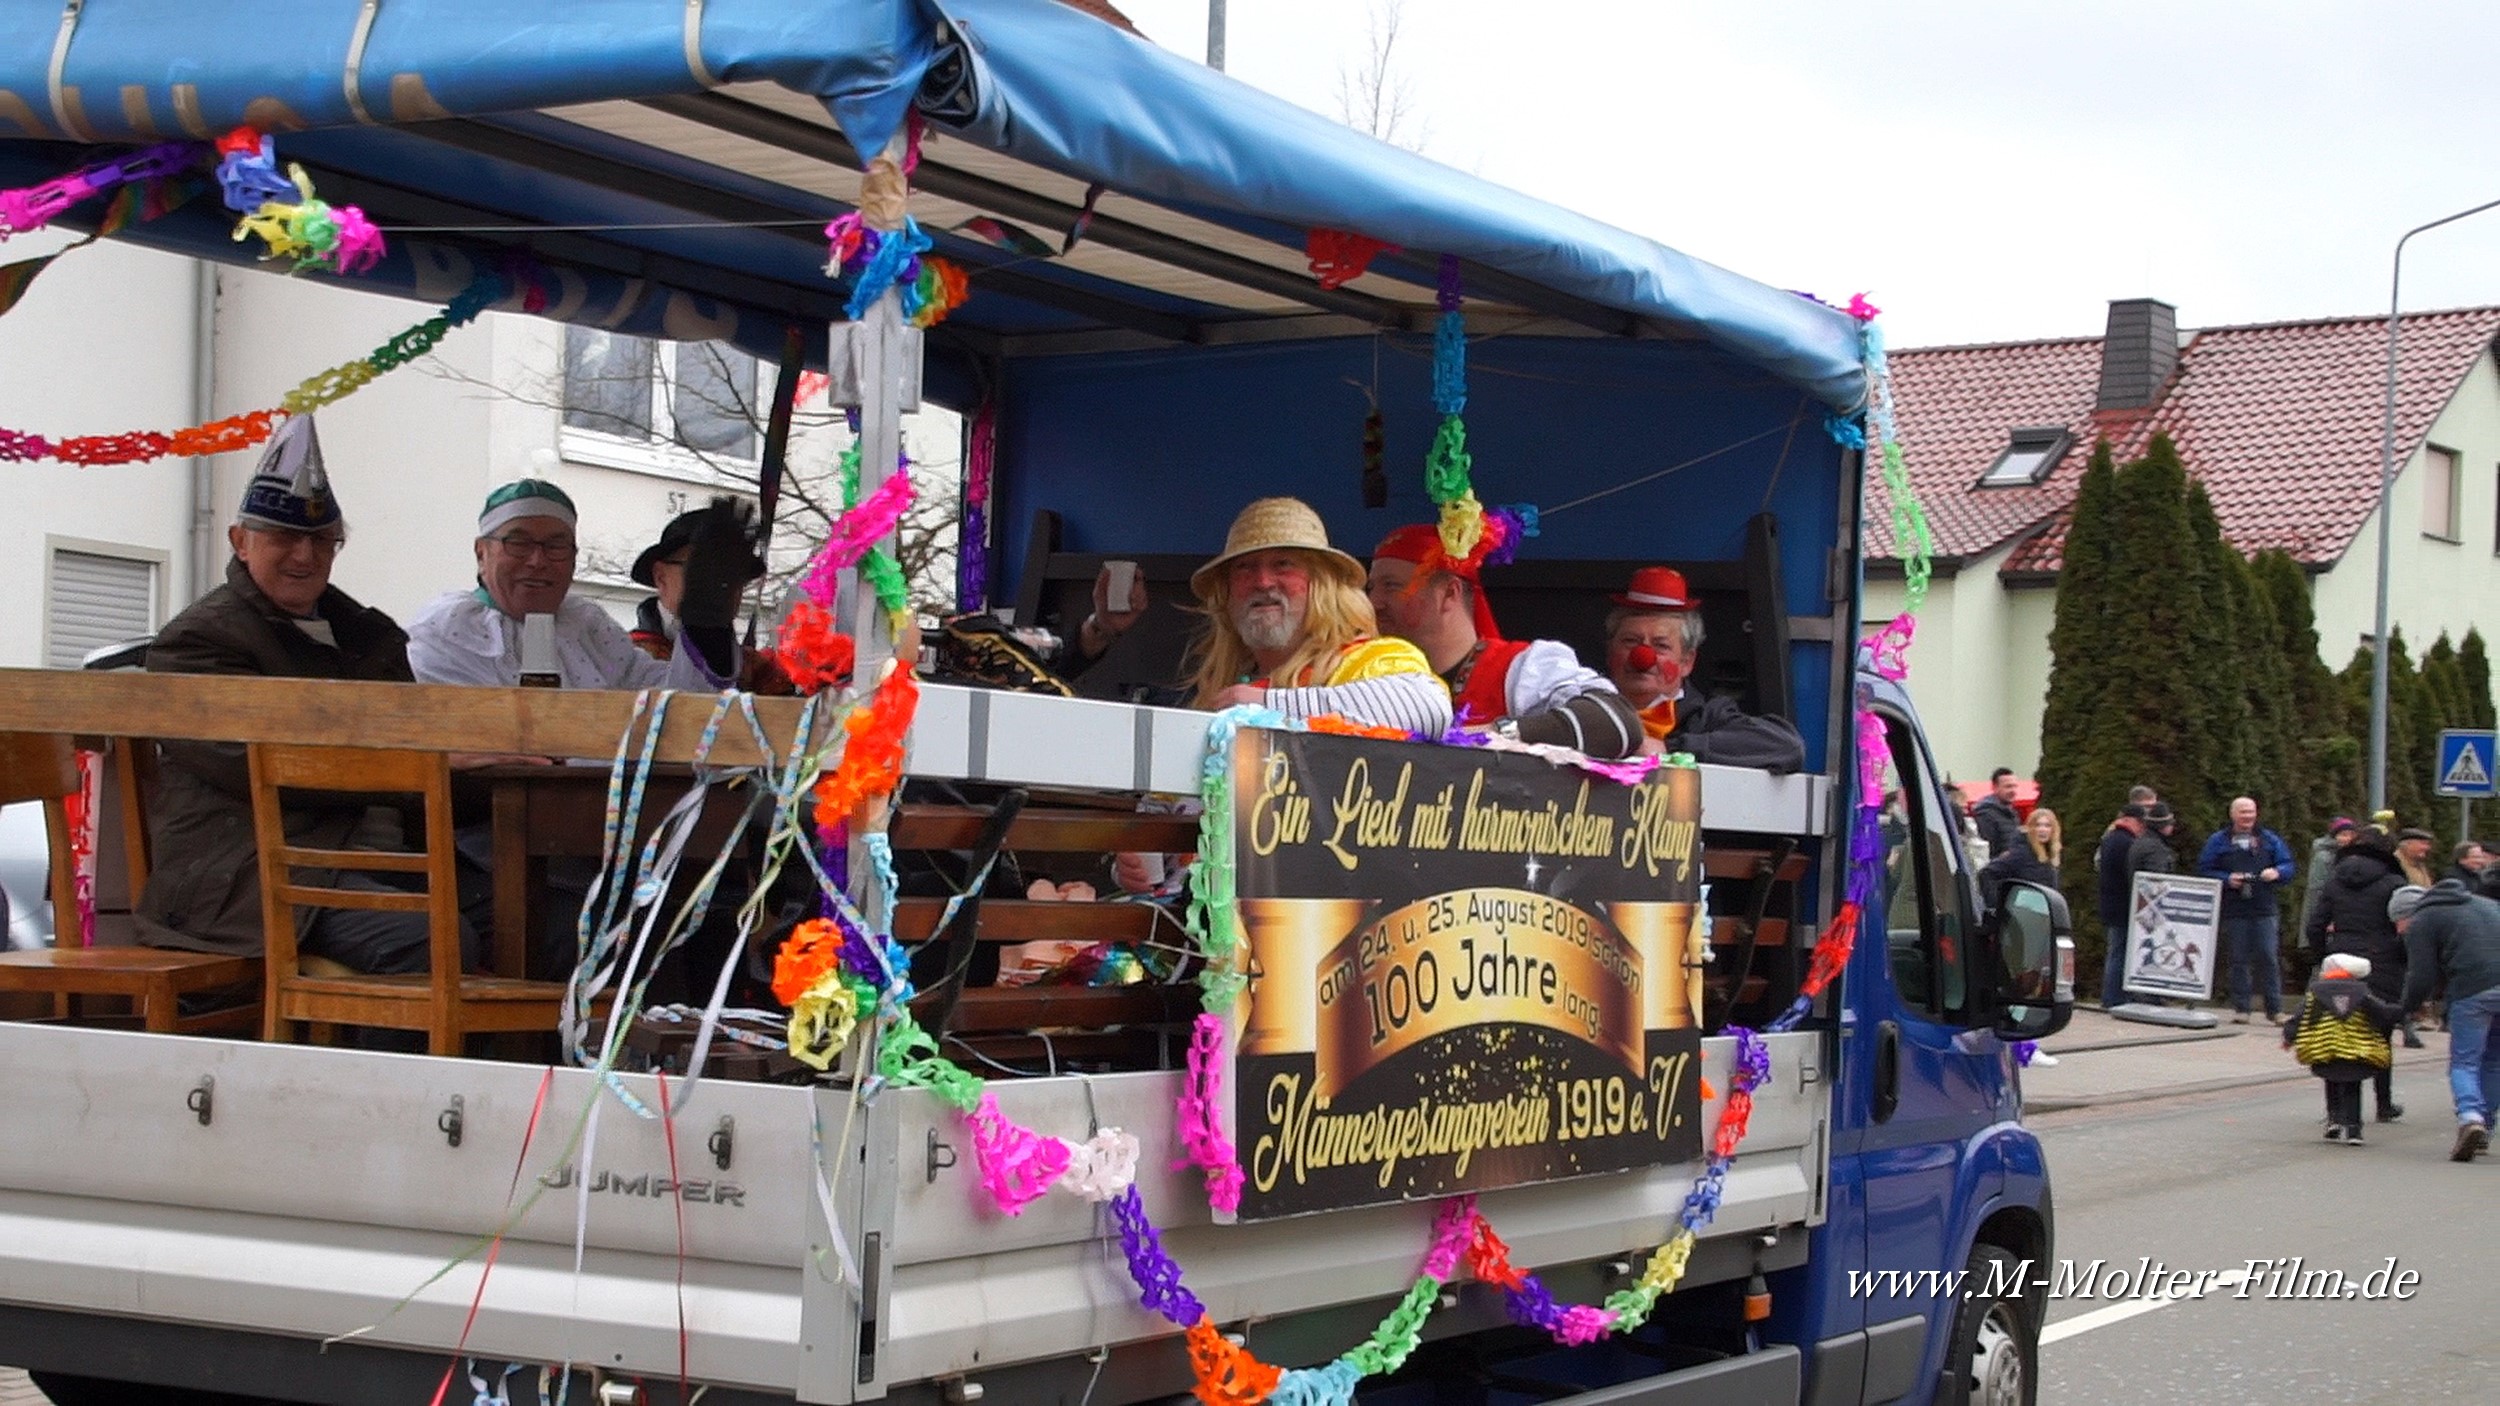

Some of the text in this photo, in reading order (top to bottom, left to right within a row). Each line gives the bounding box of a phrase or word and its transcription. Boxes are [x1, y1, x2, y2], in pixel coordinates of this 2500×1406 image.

[1251, 752, 1696, 882] Ein Lied mit harmonischem Klang
[1319, 891, 1640, 1005] am 24. u. 25. August 2019 schon
[1364, 950, 1439, 1047] 100
[1452, 936, 1557, 1004] Jahre
[1254, 1052, 1689, 1192] Männergesangverein 1919 e. V.
[547, 1163, 746, 1207] JUMPER
